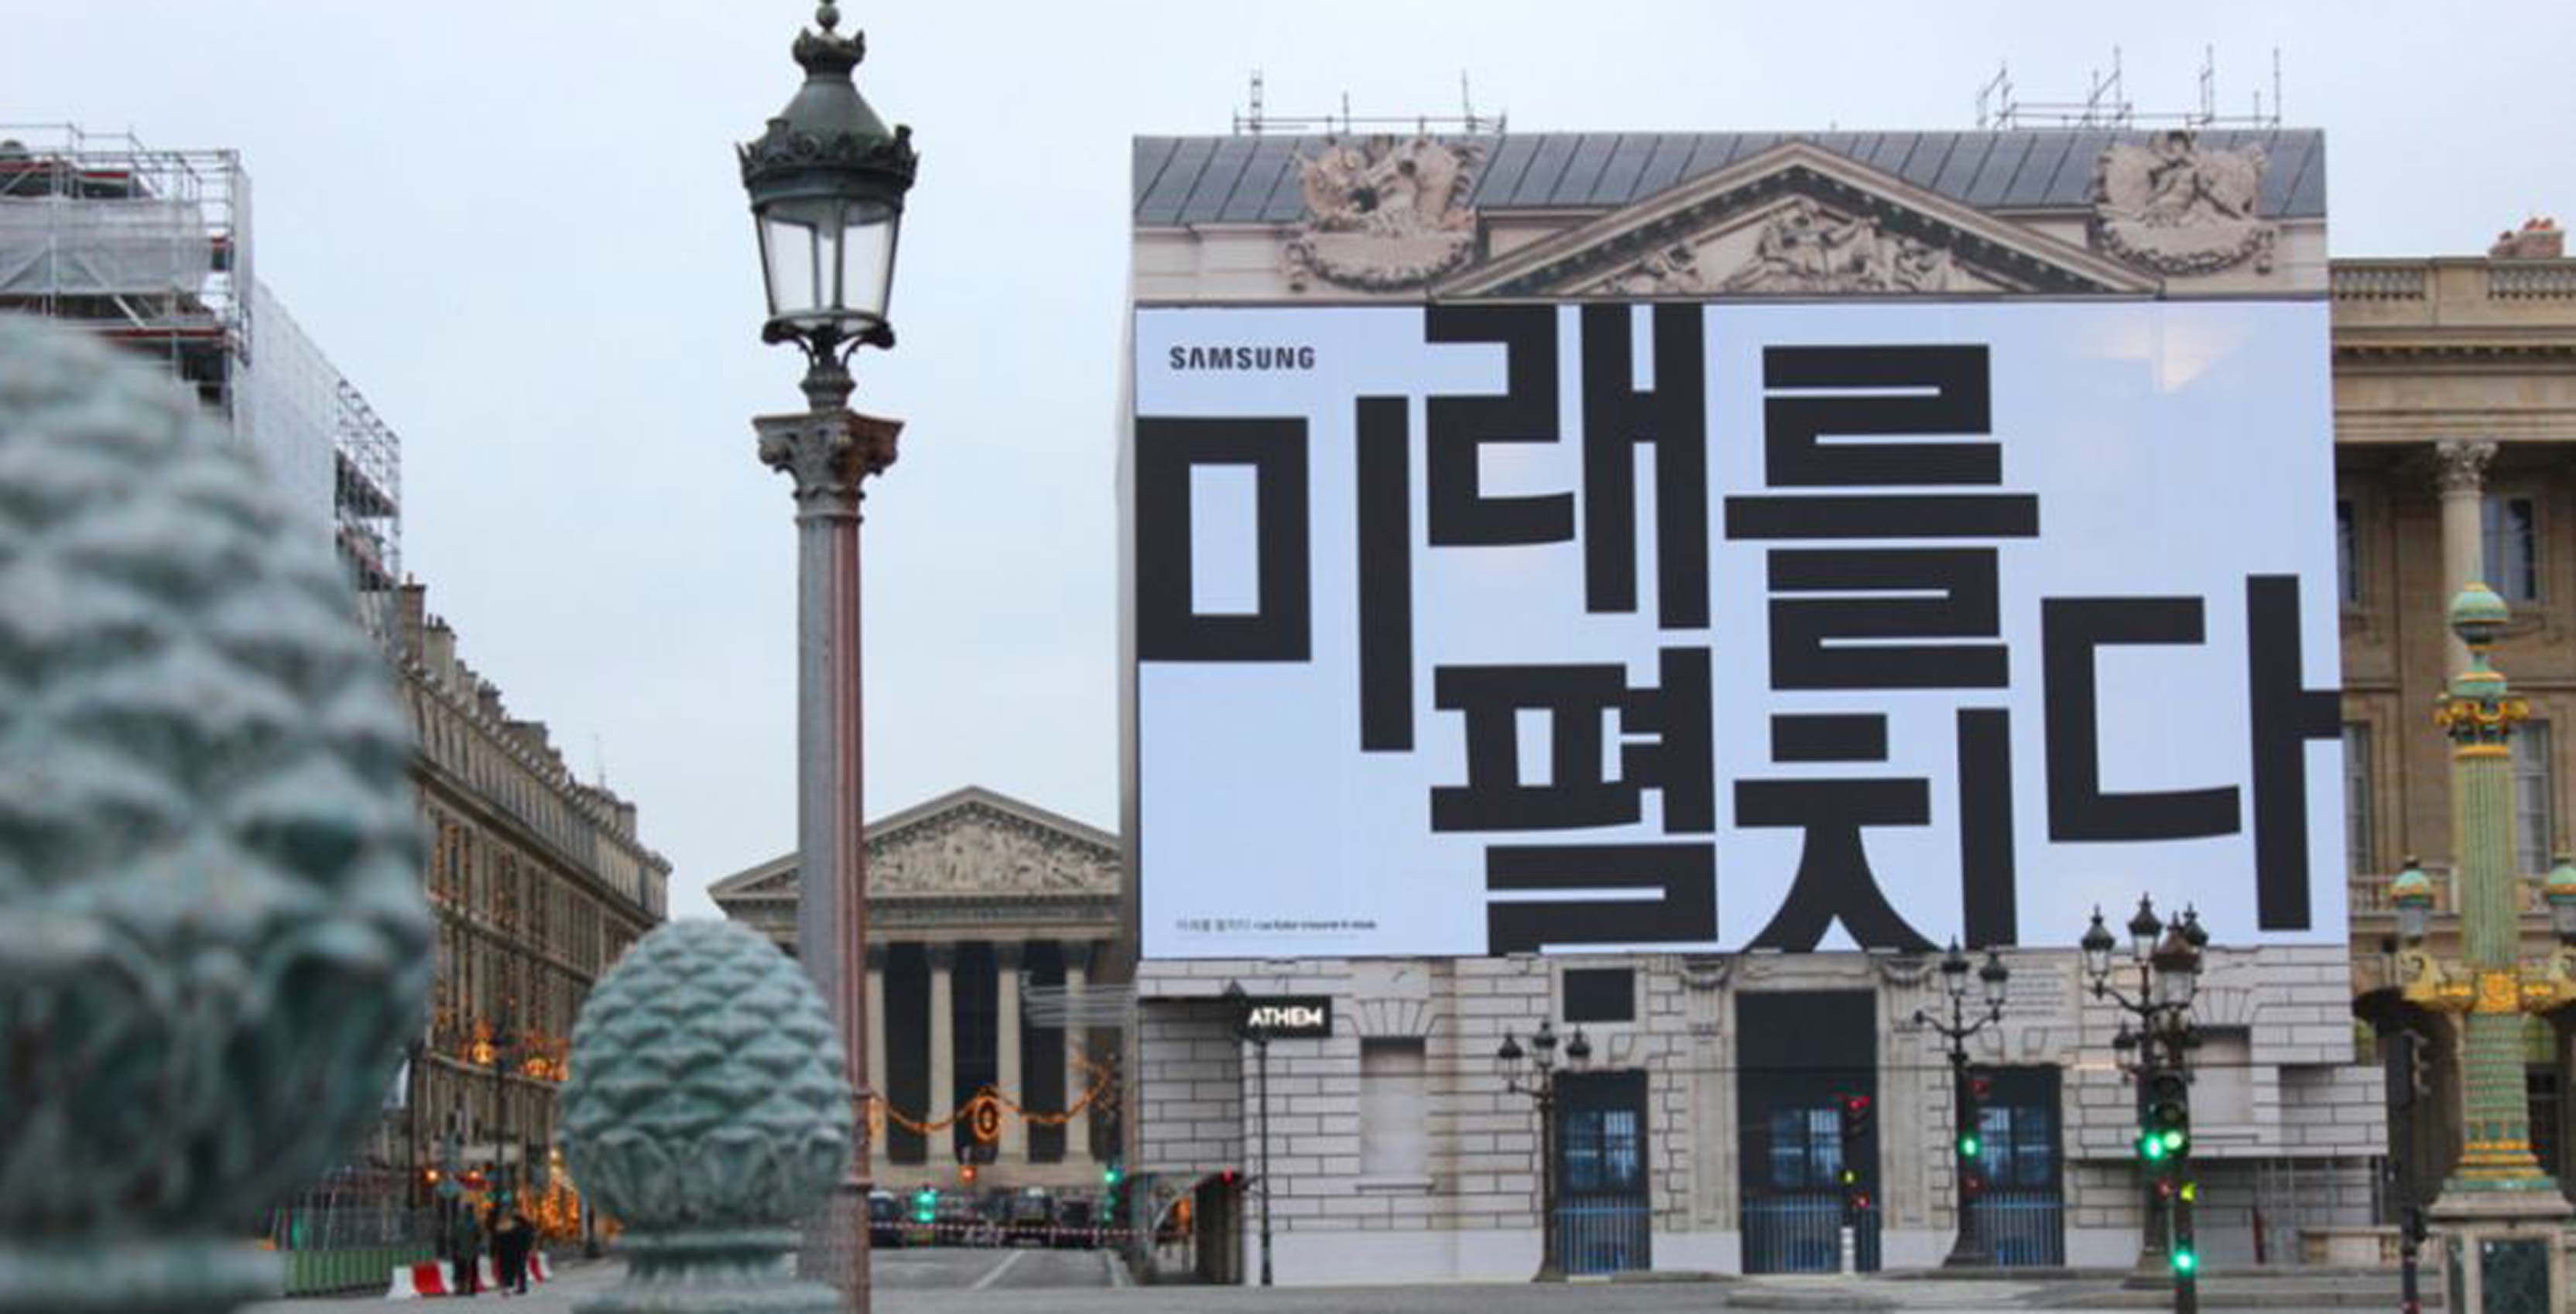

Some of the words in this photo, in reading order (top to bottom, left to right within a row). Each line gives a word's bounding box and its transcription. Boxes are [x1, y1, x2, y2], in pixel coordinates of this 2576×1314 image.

[1169, 346, 1315, 370] SAMSUNG
[1136, 303, 2040, 751] 미래를
[1430, 574, 2341, 956] 펼치다
[1248, 1006, 1322, 1027] ATHEM
